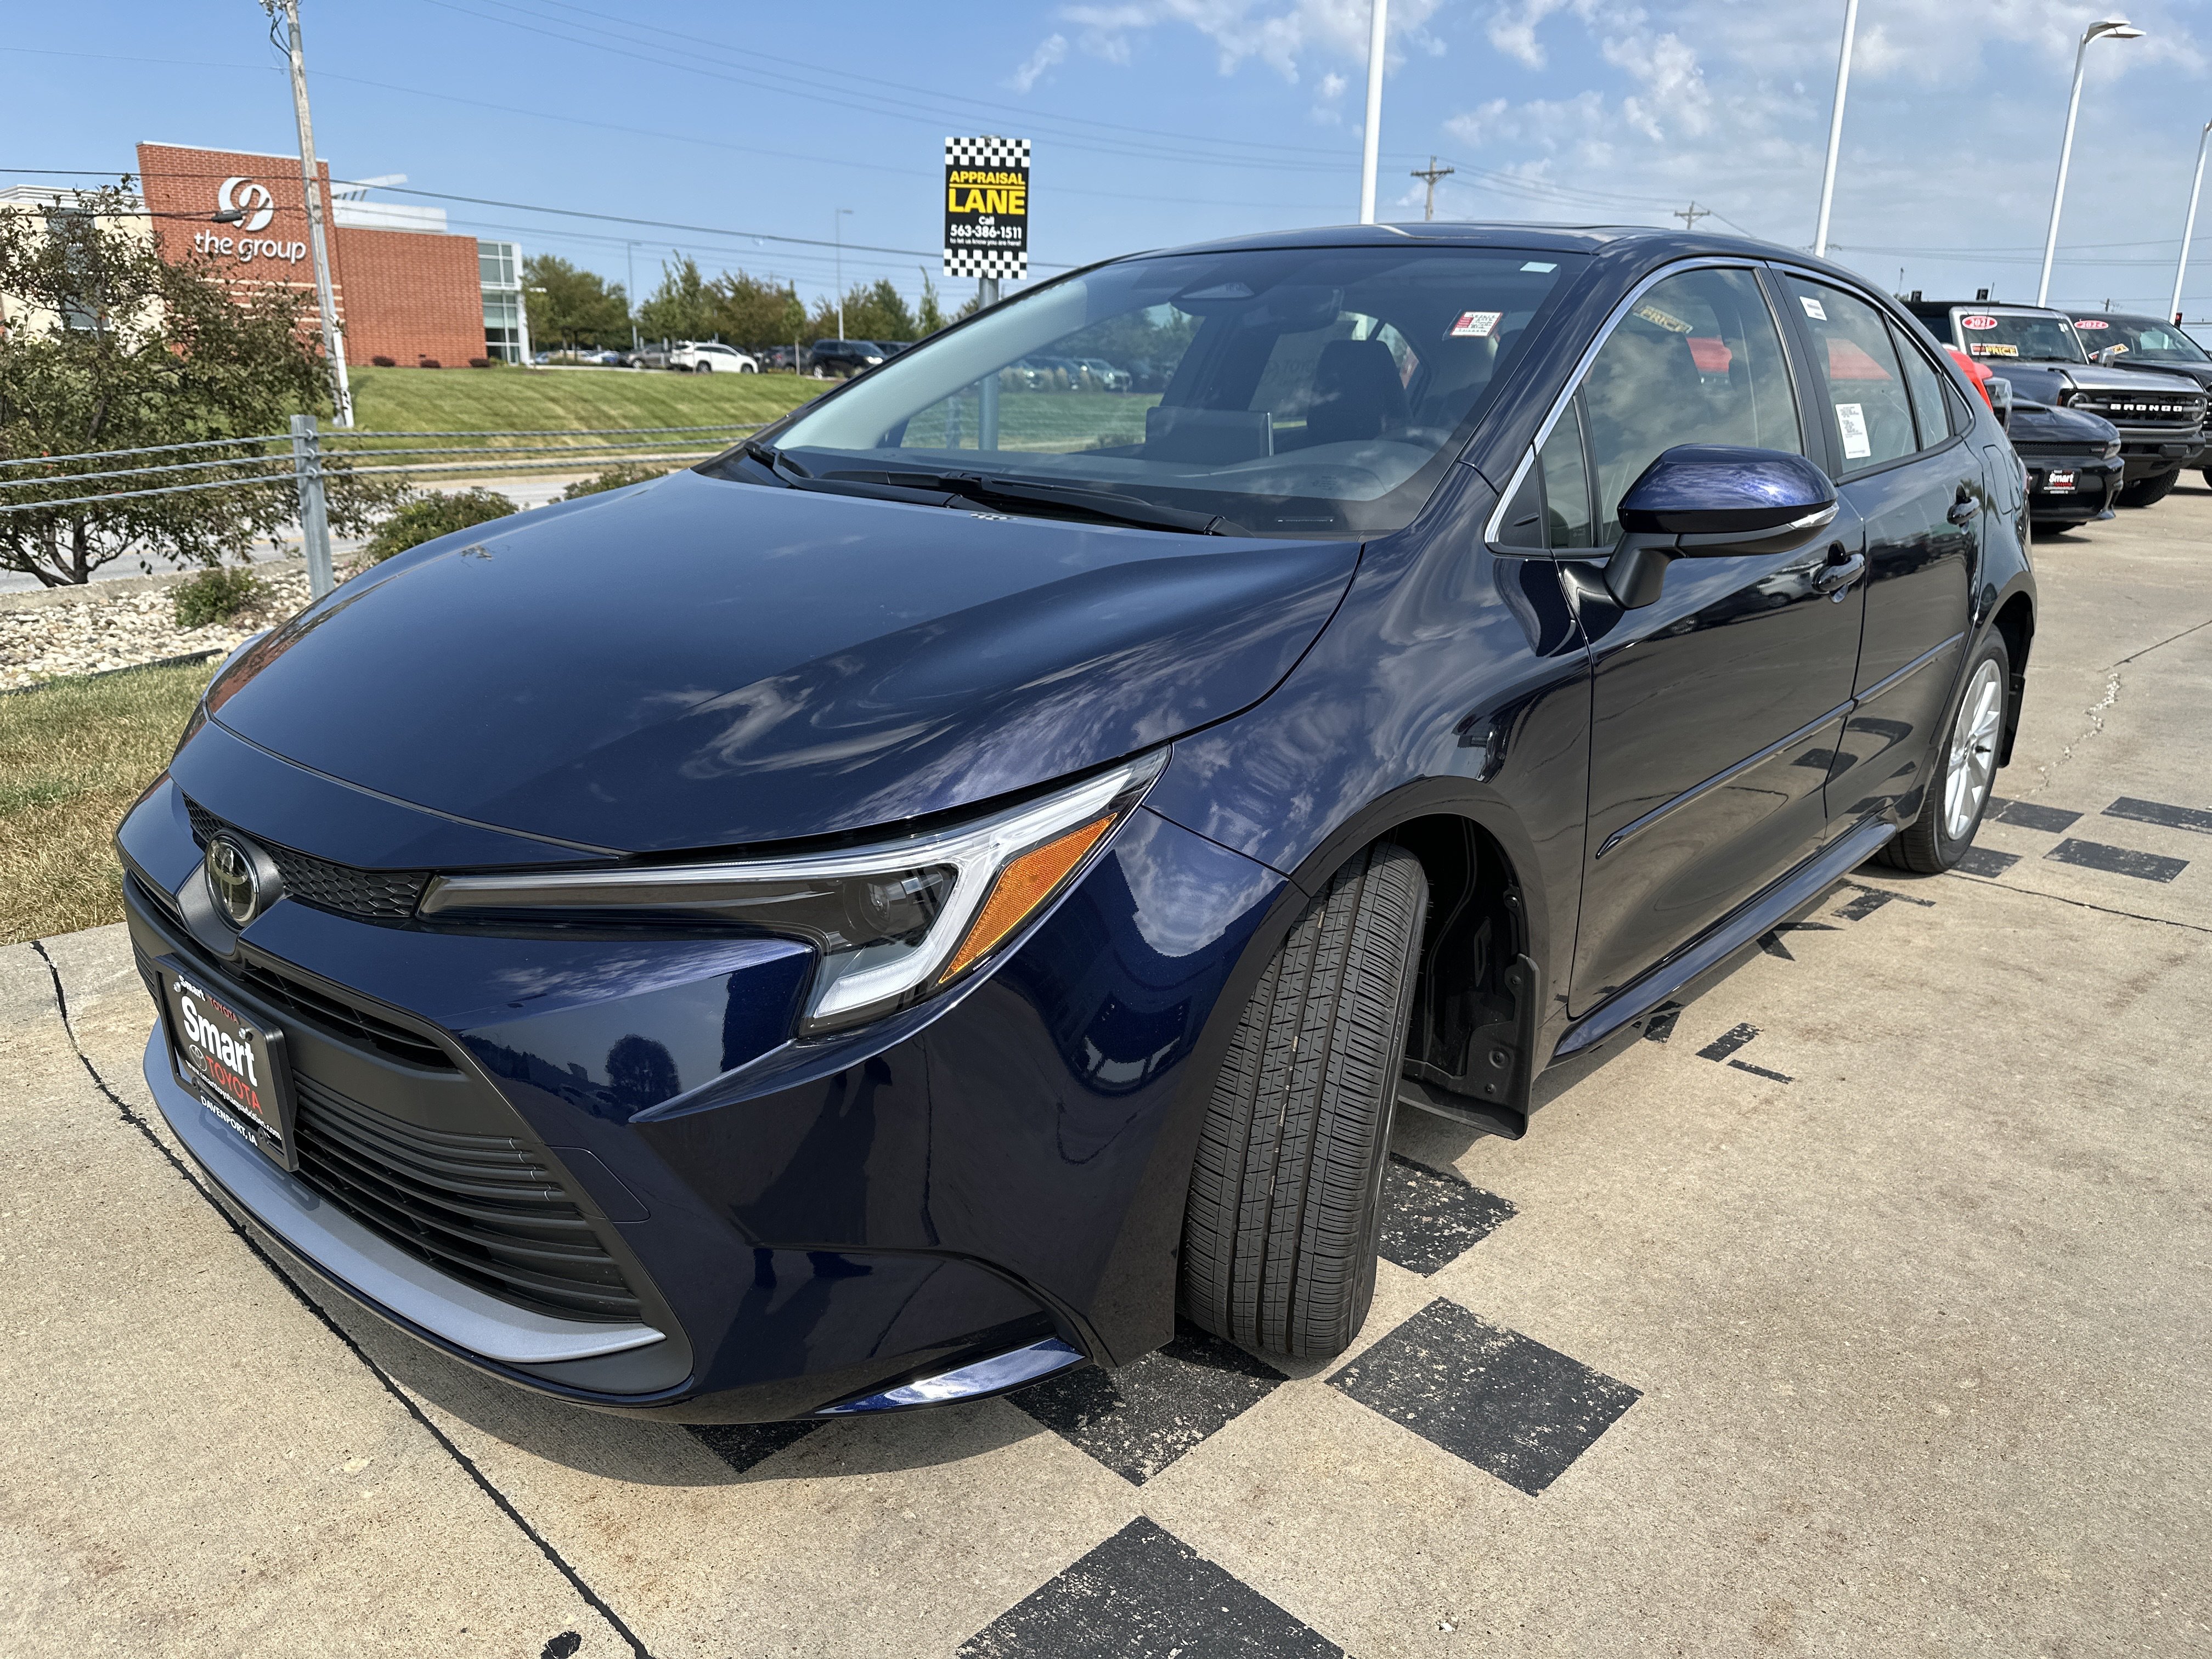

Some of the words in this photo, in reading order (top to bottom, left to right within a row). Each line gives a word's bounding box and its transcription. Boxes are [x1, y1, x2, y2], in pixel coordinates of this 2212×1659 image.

[950, 171, 1025, 185] APPRAISAL
[949, 188, 1025, 215] LANE
[978, 216, 995, 225] Call
[950, 224, 1022, 239] 563-386-1511
[194, 229, 233, 255] the
[238, 238, 307, 264] group
[1985, 346, 2017, 355] PRICE
[2111, 403, 2182, 412] BRONCO
[2049, 473, 2074, 483] Smart
[178, 975, 206, 1002] Smart
[207, 995, 239, 1025] TOYOTA
[181, 996, 258, 1087] Smart
[205, 1055, 263, 1115] TOYOTA
[200, 1095, 248, 1140] DAVENPORT,
[248, 1131, 258, 1147] IA
